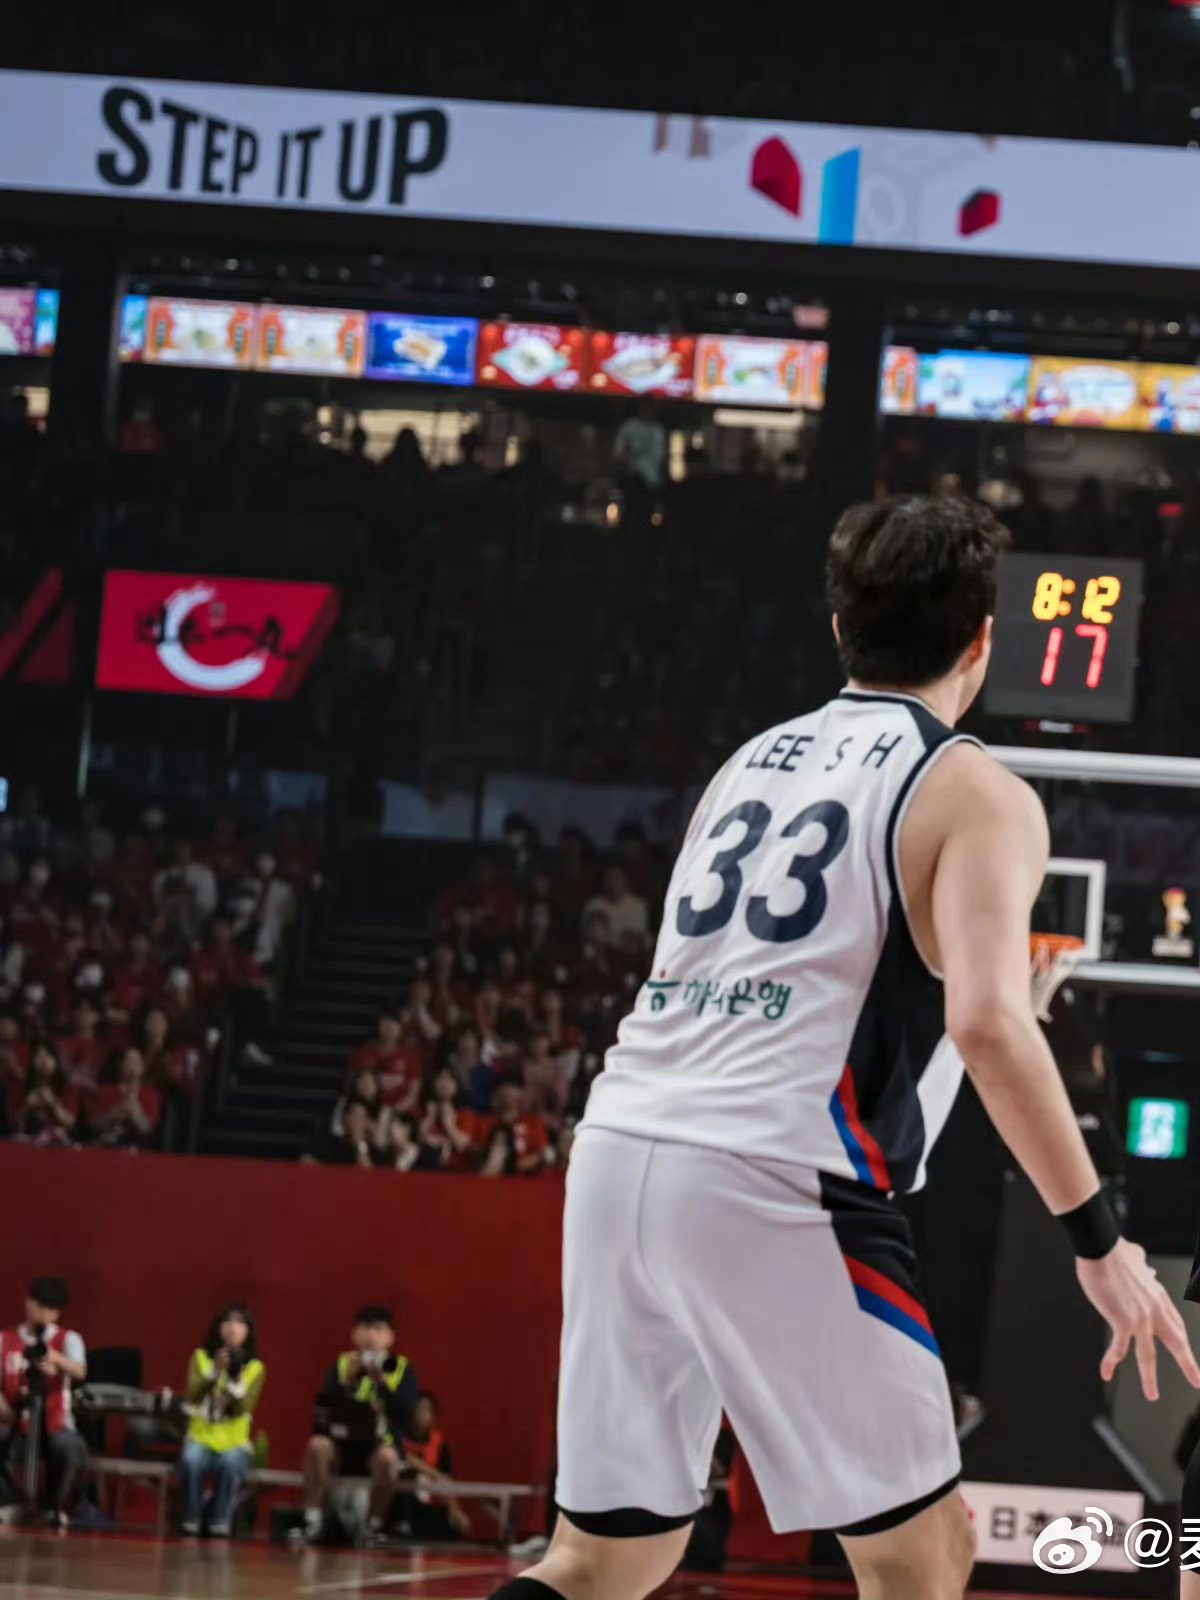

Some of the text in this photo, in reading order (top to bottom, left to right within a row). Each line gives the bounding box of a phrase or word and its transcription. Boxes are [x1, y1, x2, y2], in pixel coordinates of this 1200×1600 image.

[97, 86, 448, 206] STEP IT UP
[1032, 572, 1121, 624] 8:12
[1040, 623, 1109, 689] 17
[745, 732, 904, 772] LEE S H
[676, 799, 849, 943] 33
